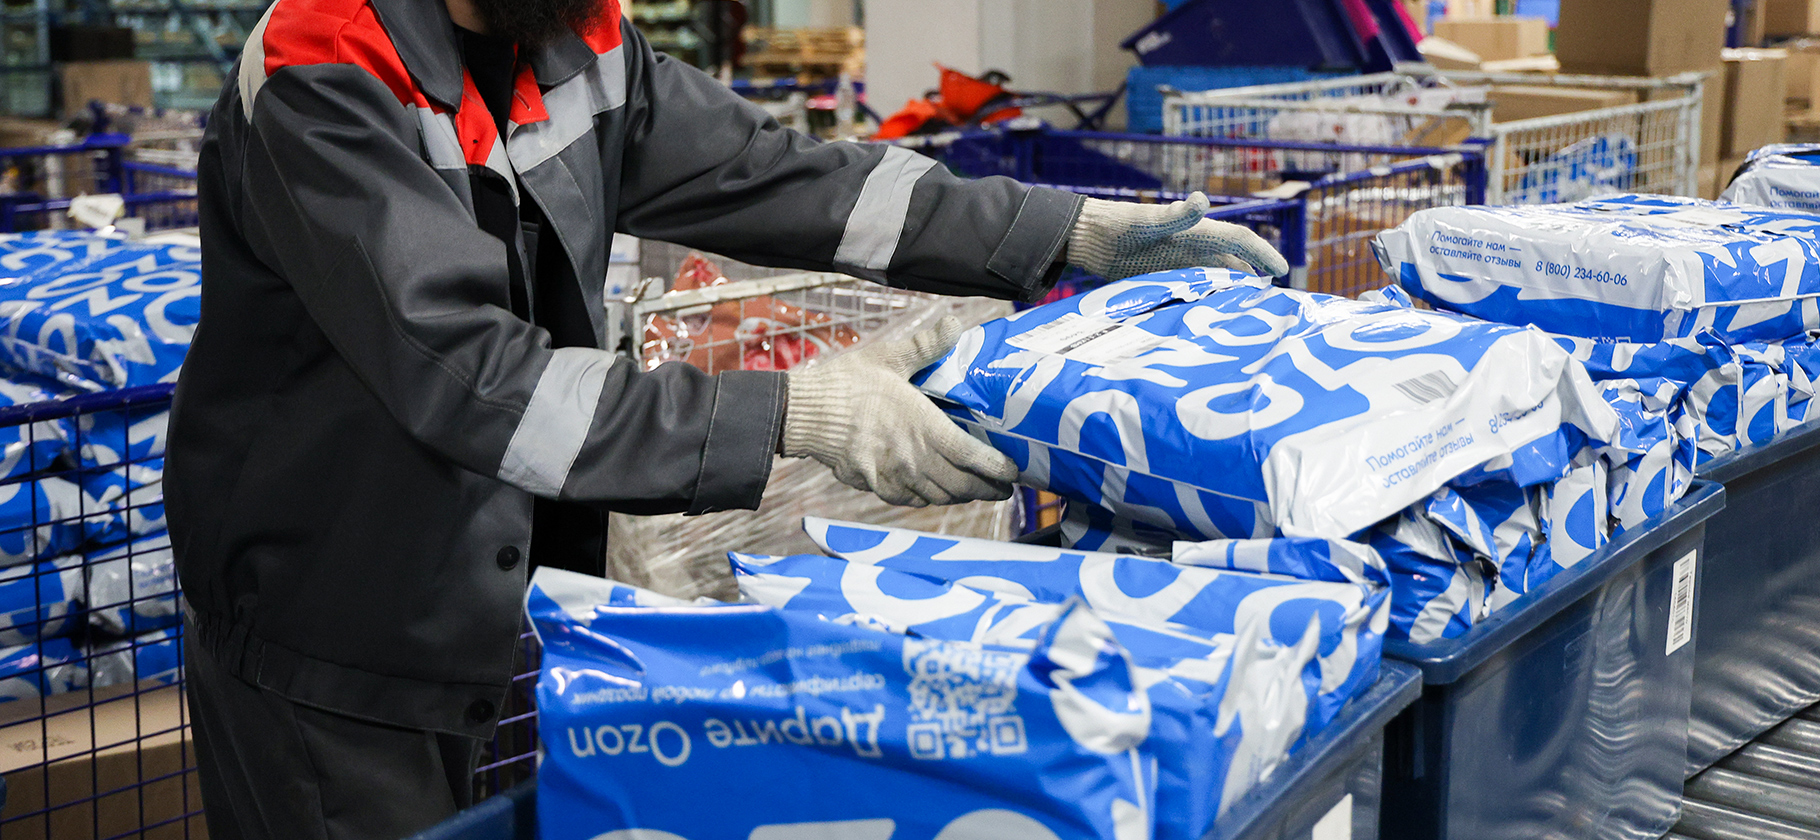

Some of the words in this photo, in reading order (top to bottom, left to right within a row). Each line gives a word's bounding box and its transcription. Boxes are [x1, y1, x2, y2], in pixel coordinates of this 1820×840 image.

[1431, 230, 1483, 249] Помогайте
[1486, 242, 1506, 252] нам
[1429, 245, 1482, 262] оставляйте
[1484, 254, 1521, 269] отзывы
[1535, 260, 1543, 272] 8
[1545, 261, 1571, 280] (800)
[1574, 267, 1627, 286] 234-60-06
[1366, 432, 1434, 472] Помогайте
[1436, 422, 1453, 438] нам
[1439, 433, 1475, 459] отзывы
[567, 720, 692, 767] Ozon
[703, 703, 886, 758] Дарите
